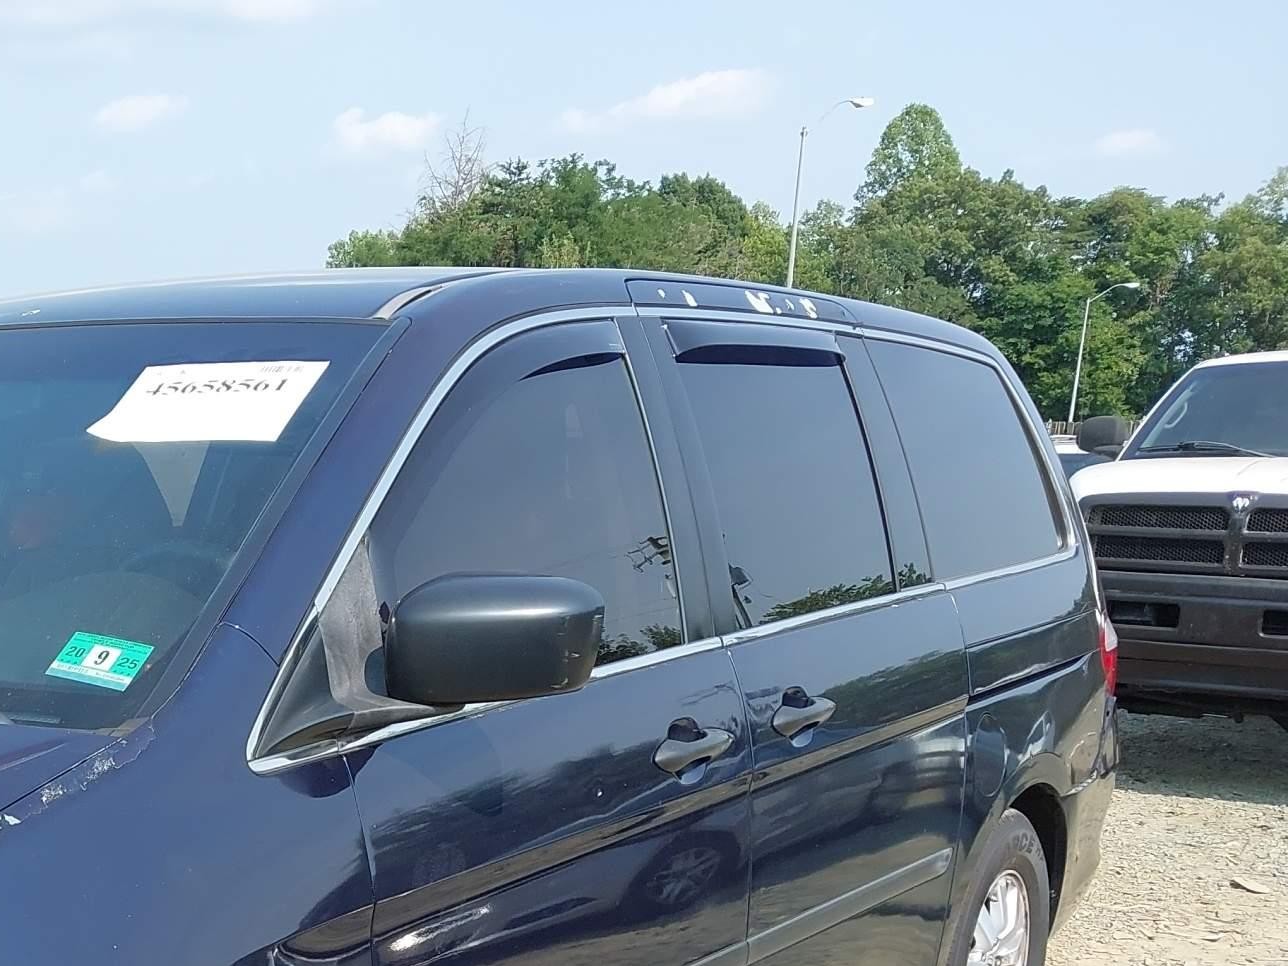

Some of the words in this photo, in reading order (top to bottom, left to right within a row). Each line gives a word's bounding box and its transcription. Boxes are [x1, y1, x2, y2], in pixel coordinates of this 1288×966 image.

[145, 378, 288, 396] 45658561
[65, 646, 87, 659] 20
[94, 650, 110, 666] 9
[117, 656, 141, 671] 25
